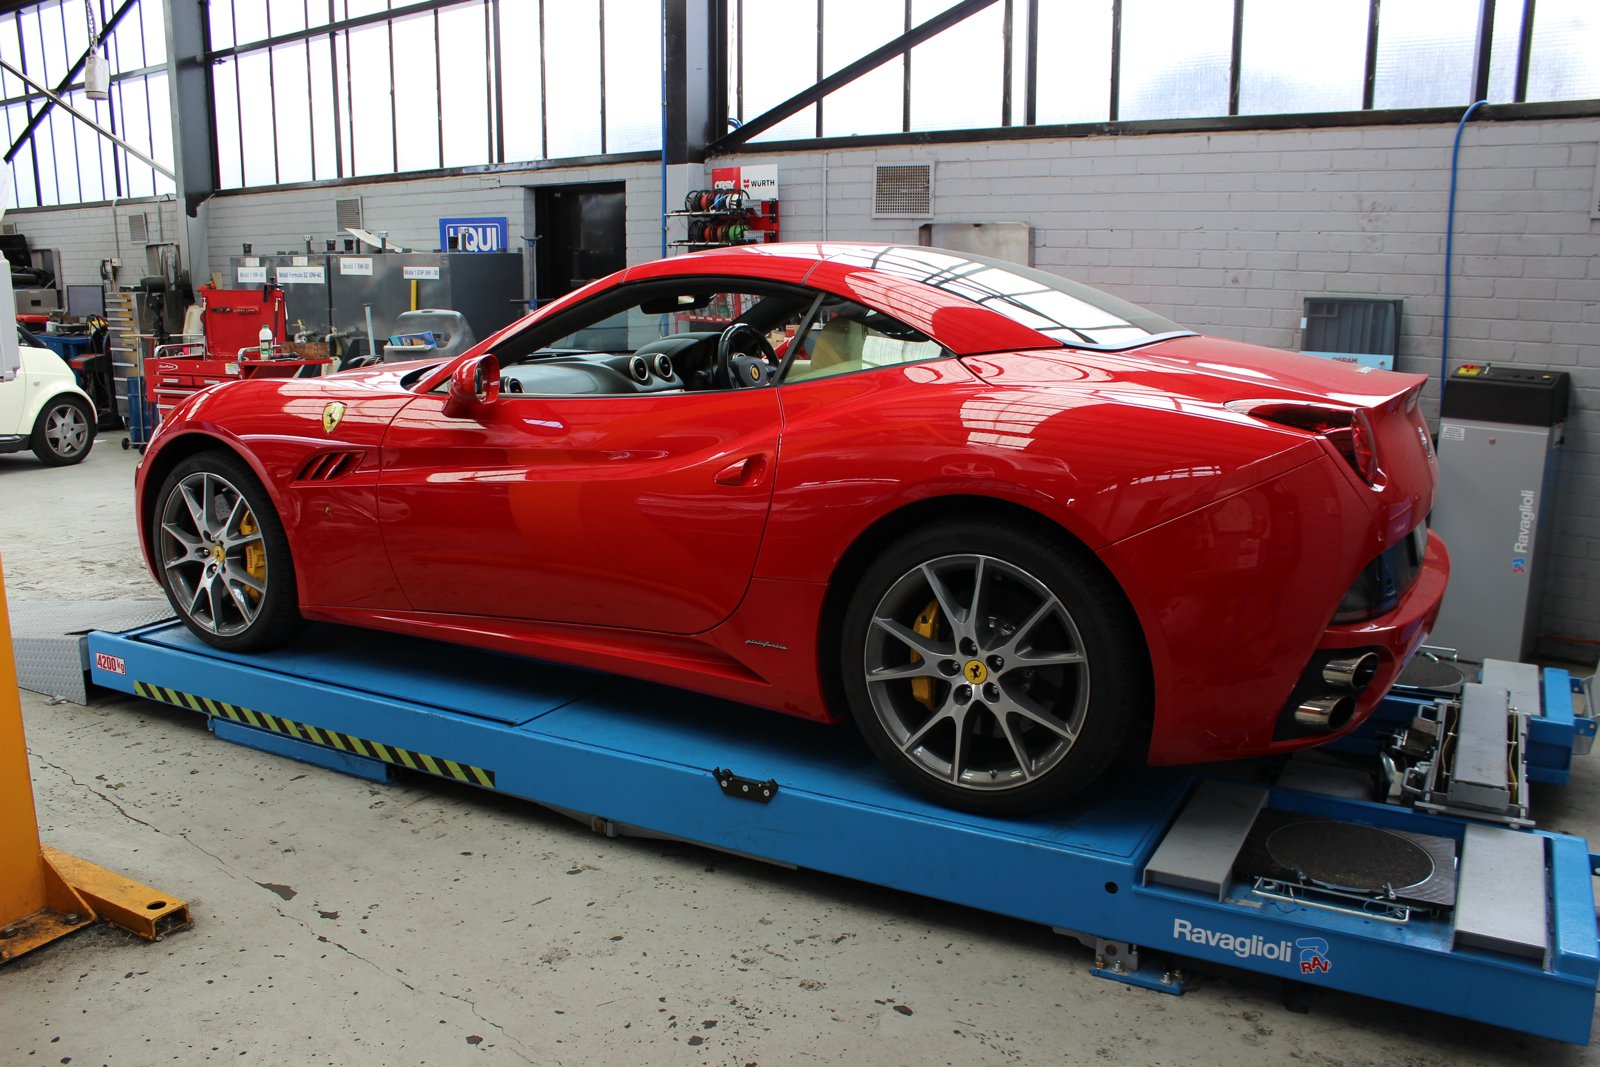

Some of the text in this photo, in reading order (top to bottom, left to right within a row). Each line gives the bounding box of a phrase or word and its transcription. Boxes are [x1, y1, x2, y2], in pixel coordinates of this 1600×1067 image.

[1513, 490, 1535, 553] Ravaglioli
[98, 655, 117, 671] 4200
[1173, 918, 1329, 974] Ravaglioli RAV
